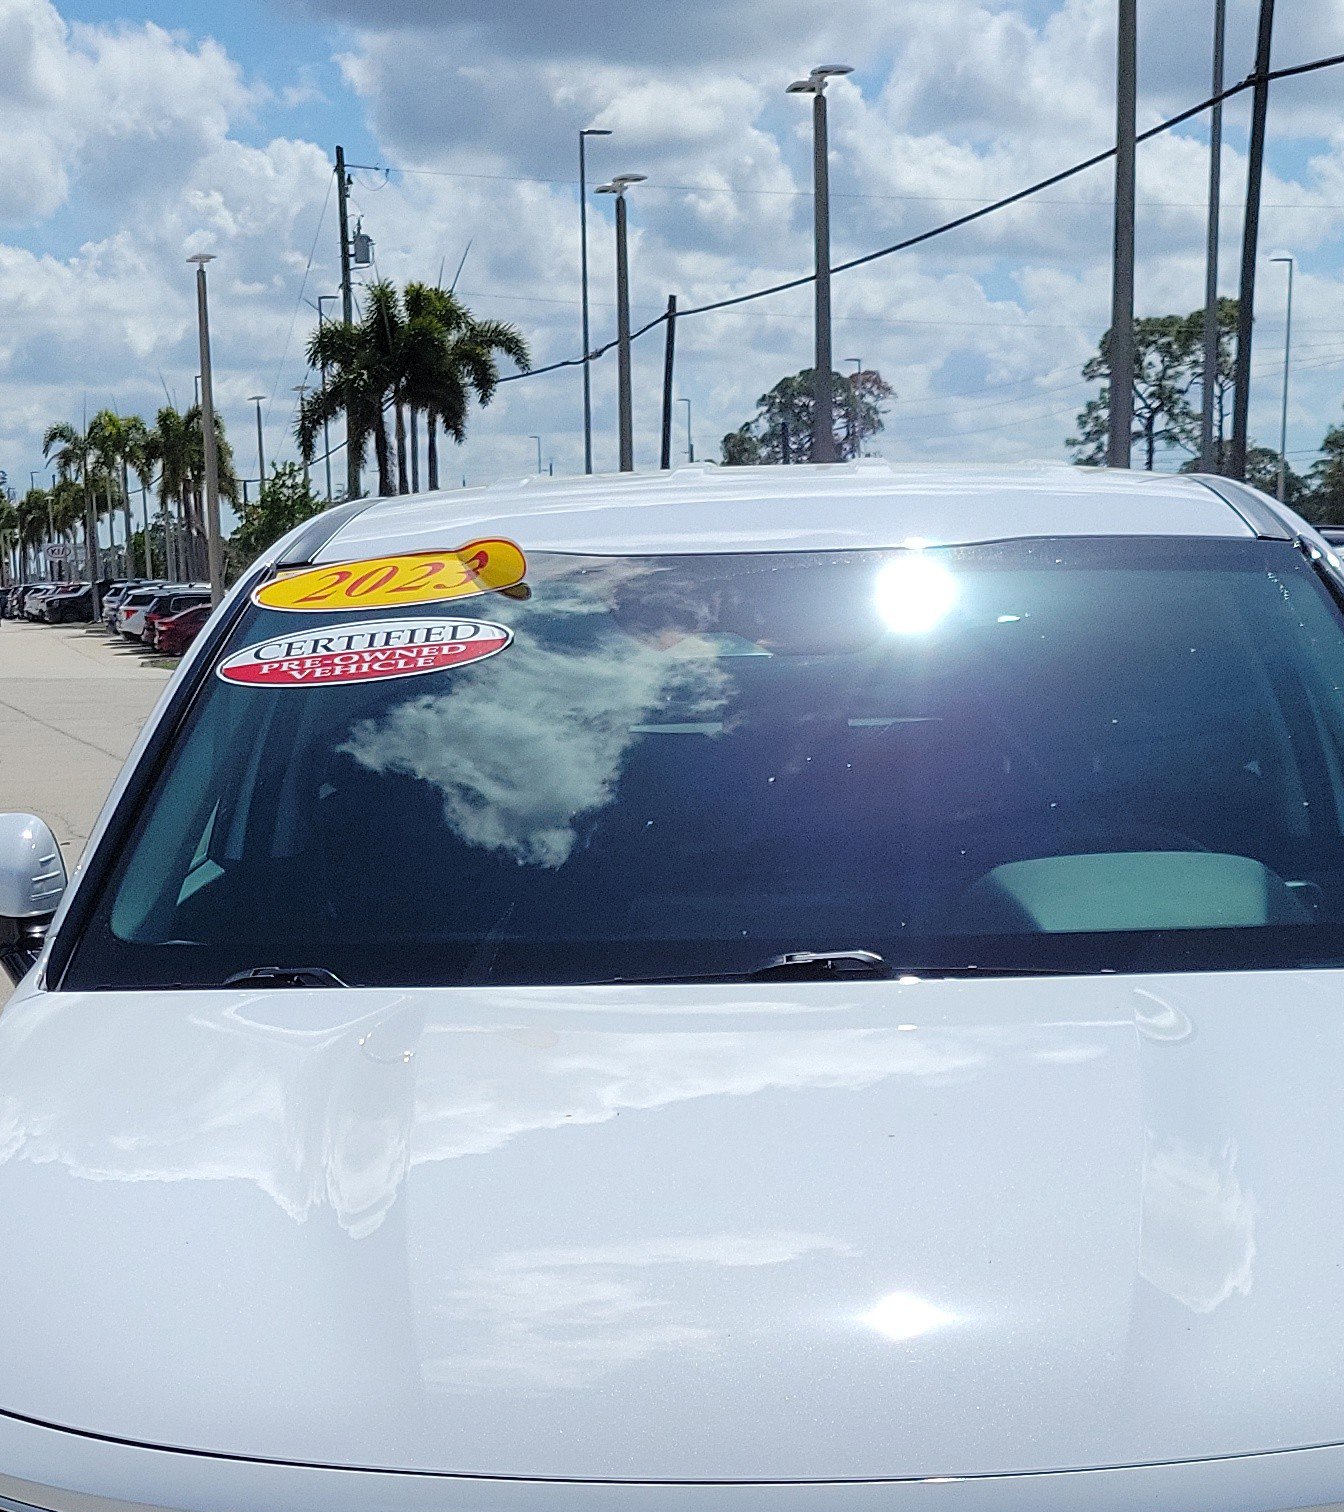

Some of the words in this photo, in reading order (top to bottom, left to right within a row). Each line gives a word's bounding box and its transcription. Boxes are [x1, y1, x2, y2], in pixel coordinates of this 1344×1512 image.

[292, 550, 489, 603] 2023
[253, 624, 480, 662] CERTIFIED
[258, 643, 467, 675] PRE-OWNED
[291, 658, 435, 681] VEHICLE
